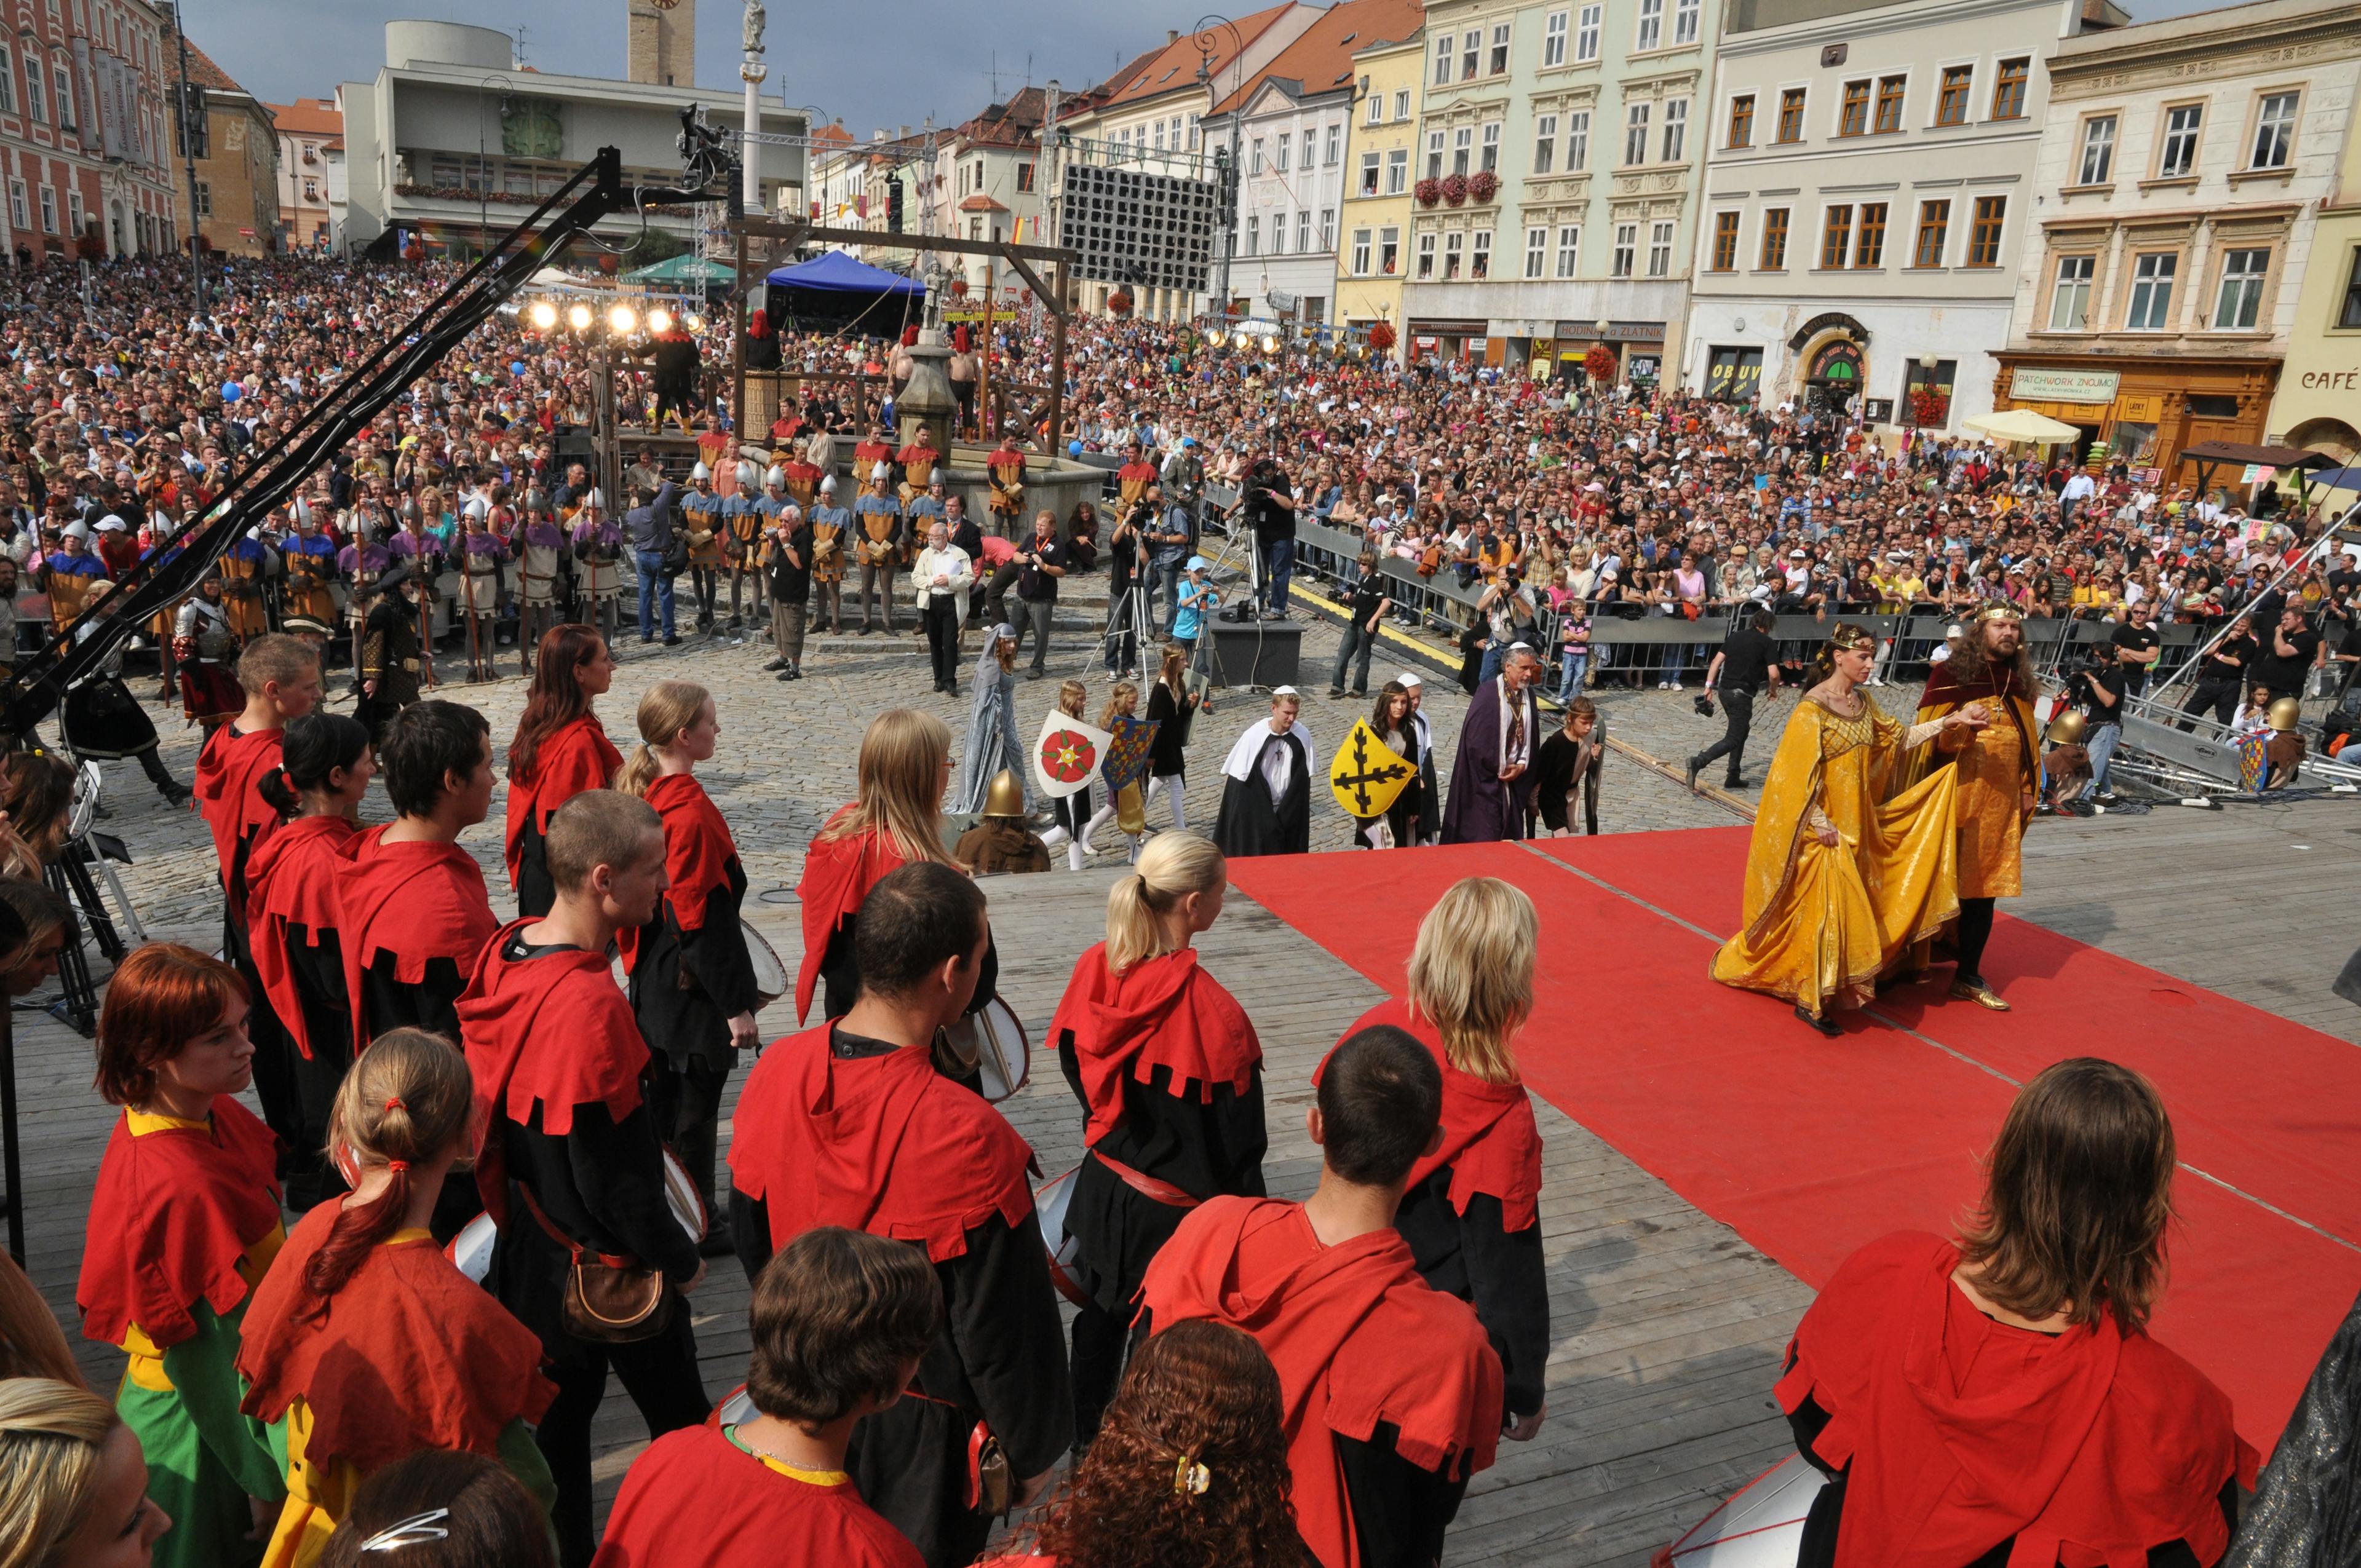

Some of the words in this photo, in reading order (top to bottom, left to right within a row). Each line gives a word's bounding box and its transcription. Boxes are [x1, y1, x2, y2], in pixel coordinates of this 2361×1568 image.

[79, 68, 89, 96] STUDIO
[82, 98, 91, 128] FITNESS
[103, 91, 113, 128] SOLÁRIUM
[1621, 325, 1663, 336] ZLATNÍK
[1712, 364, 1761, 380] OBUV
[2302, 367, 2359, 390] CAFÉ
[1711, 379, 1729, 394] SUPER
[1733, 381, 1748, 394] CENY
[2018, 374, 2073, 386] PATCHWORK
[2077, 378, 2114, 387] ZNOJMO
[2129, 400, 2145, 410] LÁTKY
[1044, 543, 1054, 552] 70
